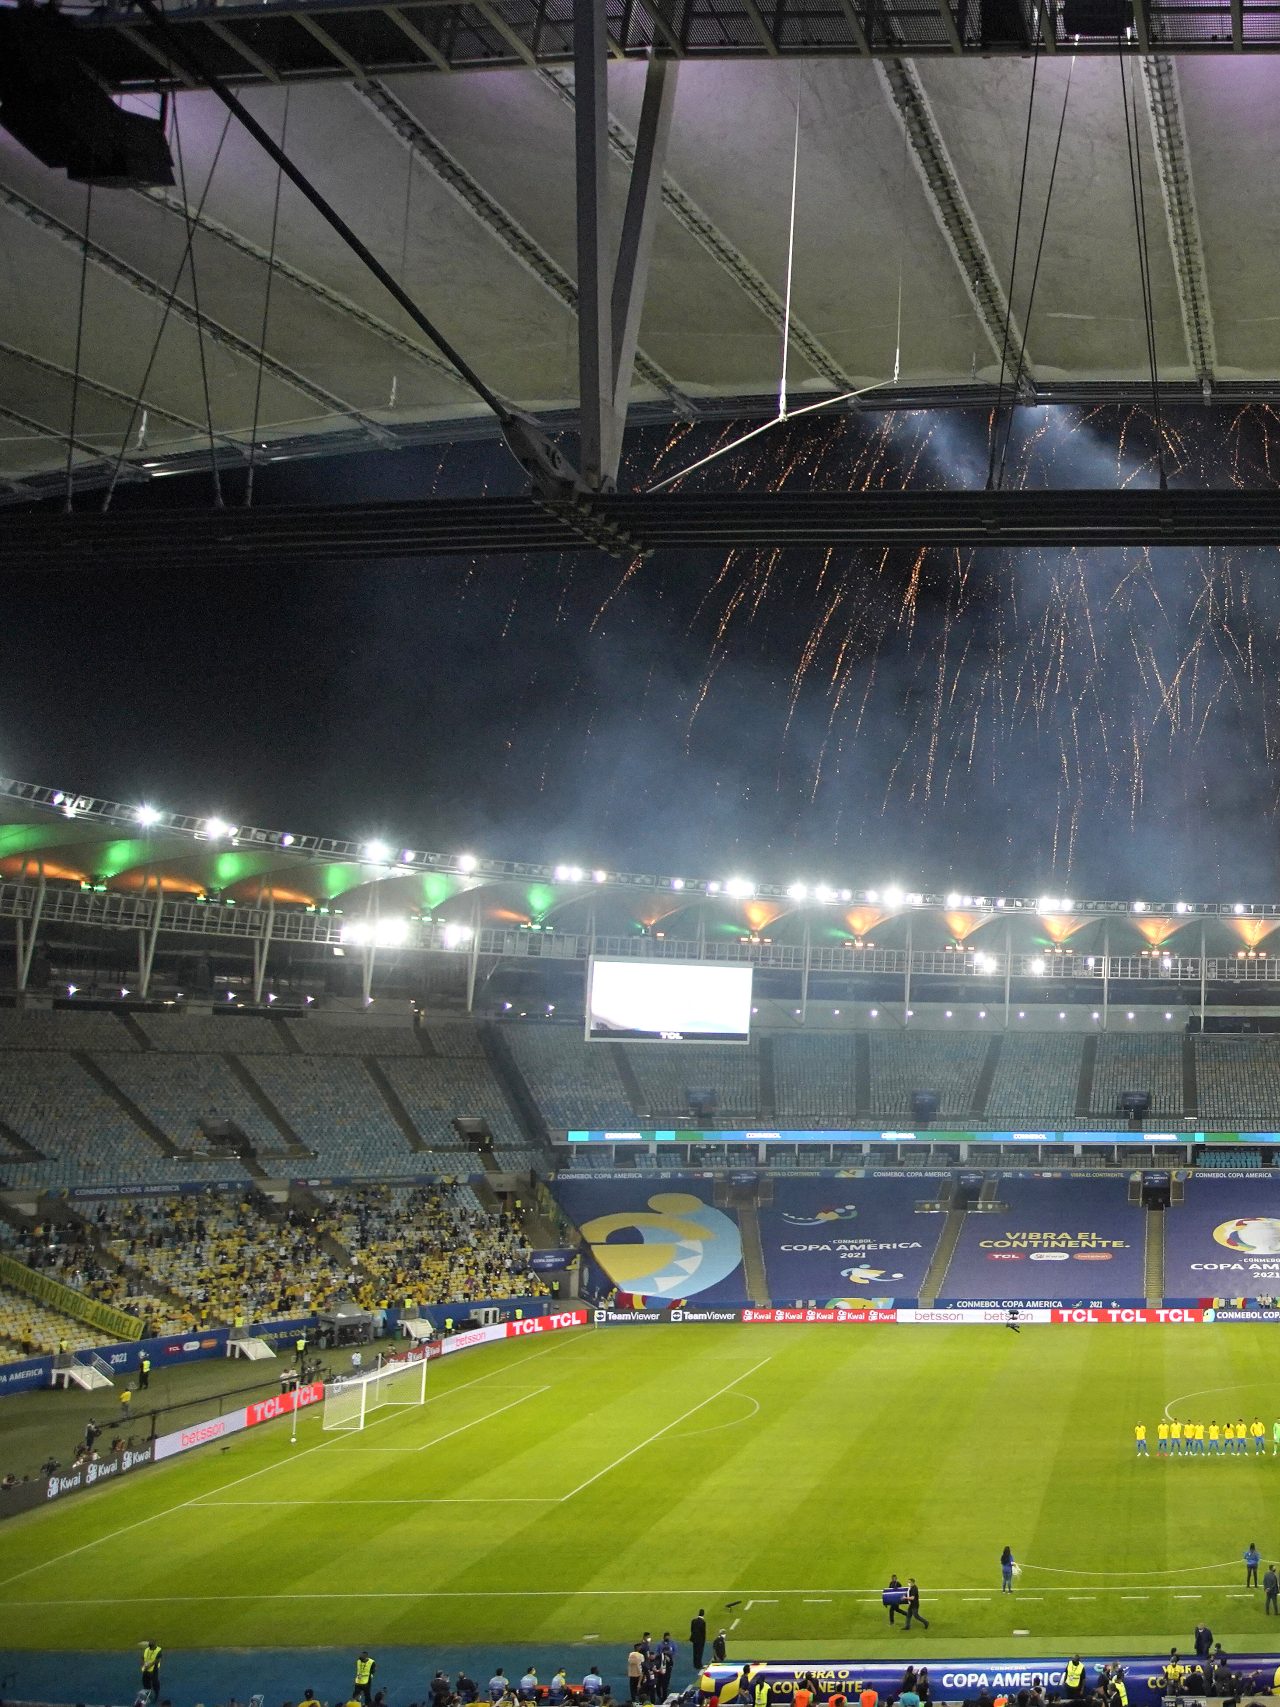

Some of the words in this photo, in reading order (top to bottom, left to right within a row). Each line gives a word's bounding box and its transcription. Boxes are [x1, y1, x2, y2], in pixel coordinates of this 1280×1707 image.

[660, 1032, 683, 1040] TCL
[558, 1172, 592, 1180] CONMEBOL
[1005, 1232, 1072, 1240] VIBRA
[781, 1243, 829, 1252] COPA
[836, 1242, 923, 1251] AMERICA
[979, 1240, 1131, 1248] CONTINENTE.
[1190, 1263, 1244, 1271] COPA
[1252, 1271, 1280, 1279] 2021
[957, 1300, 999, 1308] CONMEBOL
[1001, 1300, 1025, 1308] COPA
[1026, 1300, 1063, 1308] AMERICA
[549, 1312, 581, 1327] TCL
[607, 1311, 660, 1321] TeamViewer
[683, 1311, 736, 1321] TeamViewer
[753, 1312, 772, 1320] Kwai
[784, 1312, 803, 1320] Kwai
[816, 1312, 834, 1320] Kwai
[847, 1312, 865, 1320] Kwai
[878, 1312, 896, 1320] Kwai
[914, 1311, 964, 1321] betsson
[1058, 1309, 1099, 1322] TCL
[1107, 1309, 1147, 1322] TCL
[1155, 1309, 1195, 1322] TCL
[1216, 1311, 1262, 1319] CONMEBOL
[512, 1319, 543, 1335] TCL
[110, 1353, 127, 1364] 2021
[9, 1368, 43, 1381] AMERICA
[290, 1387, 318, 1410] TCL
[254, 1398, 283, 1422] TCL
[180, 1422, 224, 1447] betsson
[132, 1447, 151, 1465] Kwai
[98, 1460, 118, 1477] Kwai
[60, 1472, 81, 1492] Kwai
[838, 1669, 849, 1679] O
[942, 1673, 989, 1687] COPA
